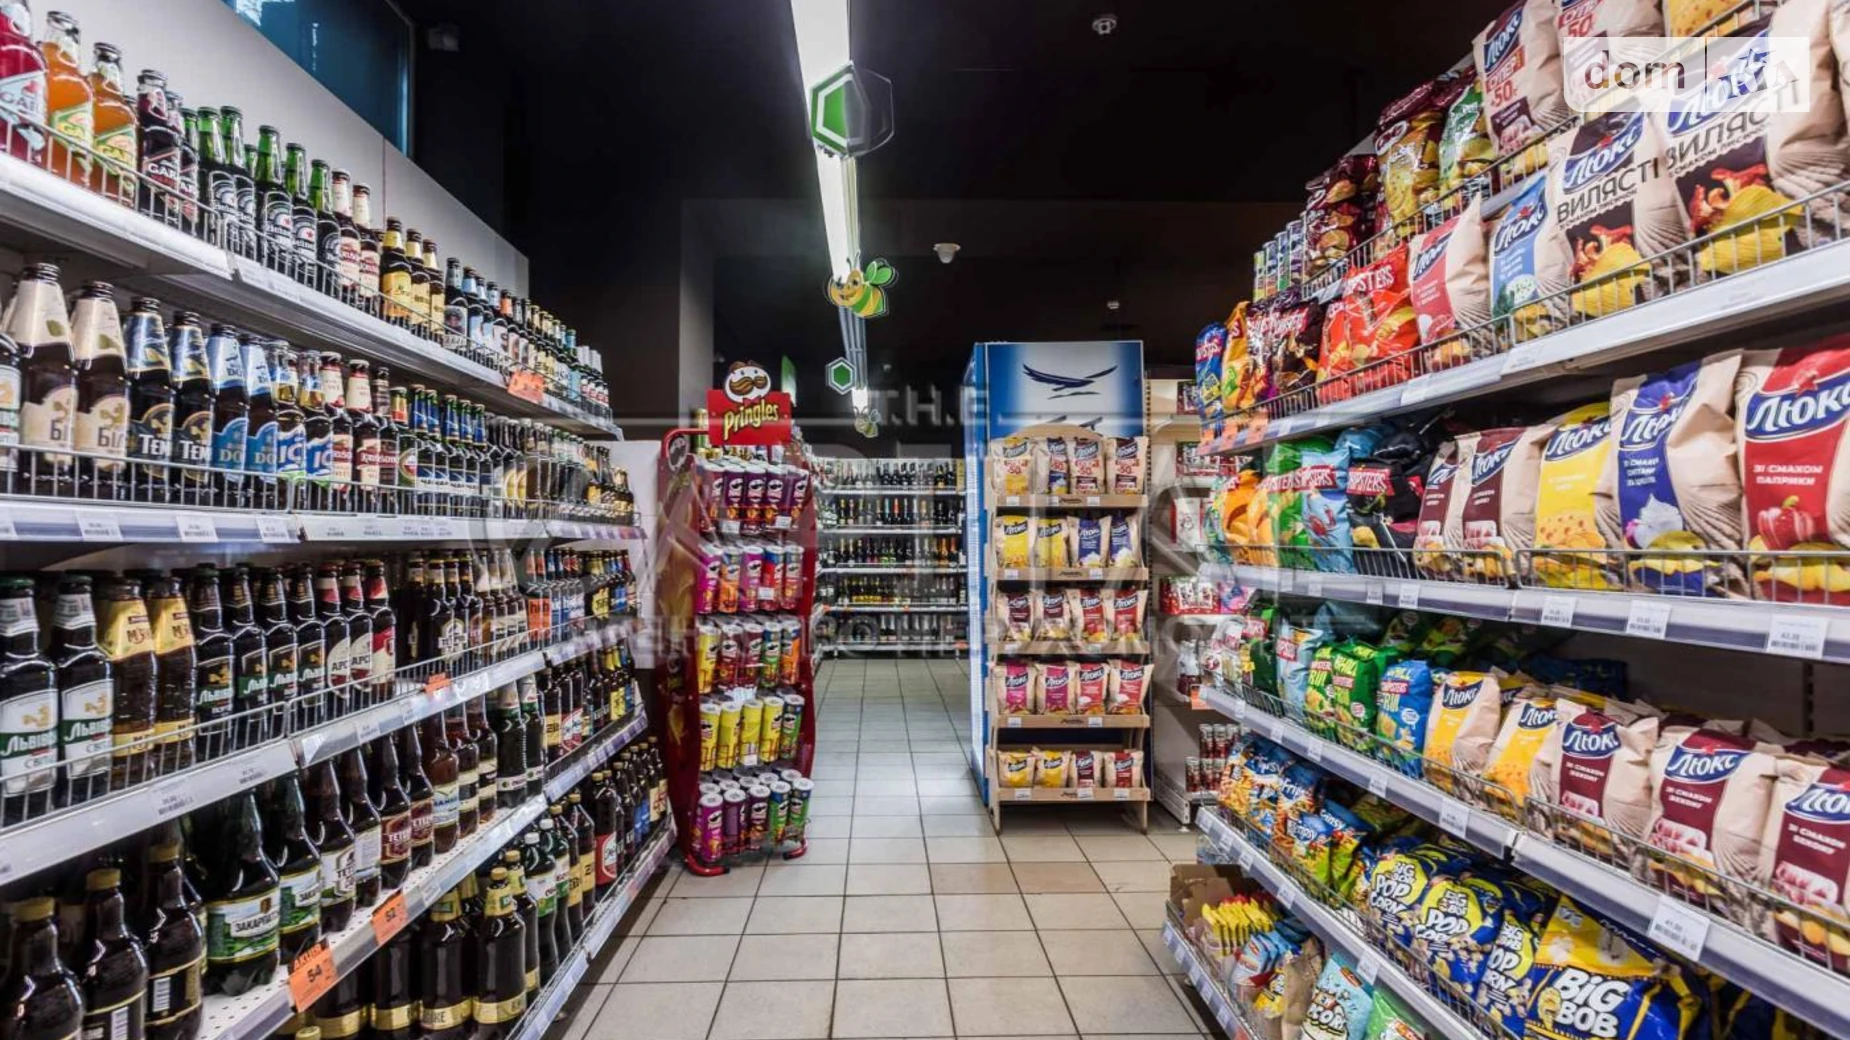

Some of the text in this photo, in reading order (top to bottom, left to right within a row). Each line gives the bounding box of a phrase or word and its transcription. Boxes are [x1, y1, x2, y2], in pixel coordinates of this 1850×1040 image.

[1563, 125, 1638, 190] Люкс
[1557, 157, 1658, 223] ВИЛЯСТІ
[723, 400, 779, 441] Pringles
[1445, 685, 1479, 706] Люкс
[1564, 727, 1620, 752] Люкс
[1667, 754, 1737, 777] Люкс
[1376, 874, 1412, 898] POP
[1427, 908, 1471, 935] POP
[306, 964, 323, 984] 54
[1557, 1002, 1618, 1039] BOB
